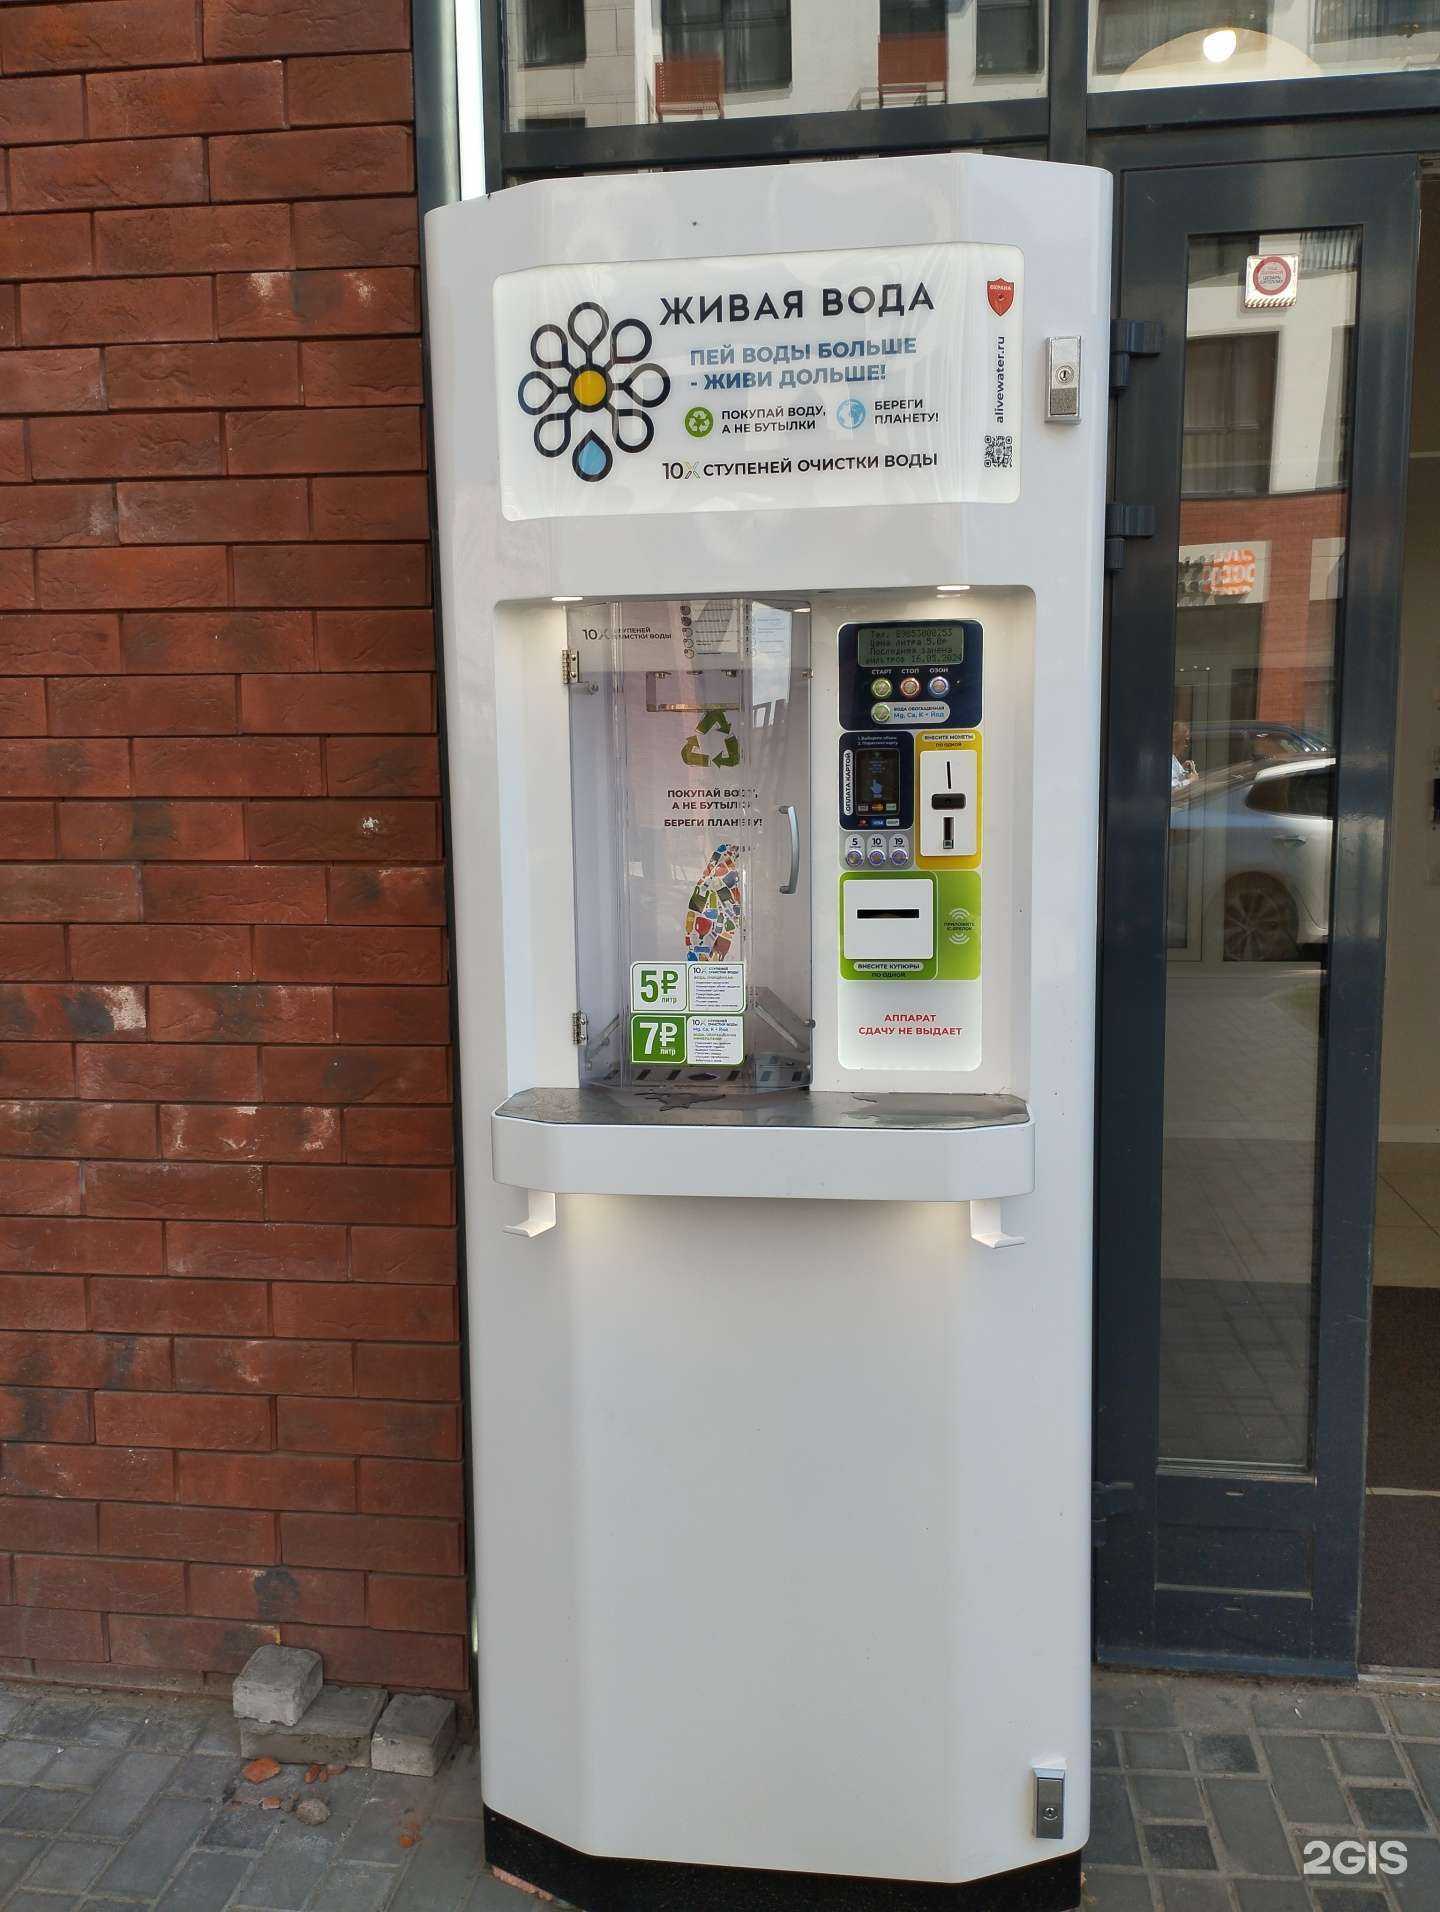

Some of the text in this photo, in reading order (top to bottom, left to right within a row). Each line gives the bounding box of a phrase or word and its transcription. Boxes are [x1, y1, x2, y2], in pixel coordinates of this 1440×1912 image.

[659, 282, 935, 325] ЖИВАЯ ВОДА
[690, 337, 917, 366] ПЕЙ ВОДЫ БОЛЬШЕ
[704, 371, 772, 390] ЖИВИ
[779, 364, 886, 388] ДОЛЬШЕ!
[994, 336, 1005, 423] alivewater.ru
[874, 399, 923, 411] БЕРЕГИ
[721, 404, 826, 420] ПОКУПАЙ ВОДУ,
[874, 412, 939, 425] ПЛАНЕТУ!
[721, 420, 816, 434] А НЕ БУТЫЛКИ
[703, 460, 792, 476] СТУПЕНЕЙ
[797, 456, 878, 472] ОЧИСТКИ
[884, 453, 937, 468] ВОДЫ
[667, 788, 720, 798] ПОКУПАЙ
[664, 819, 704, 827] БЕРЕГИ
[884, 1014, 937, 1022] АППАРАТ
[858, 1027, 963, 1036] СДАЧУ НЕ ВЫДАЕТ
[660, 1048, 676, 1056] литр
